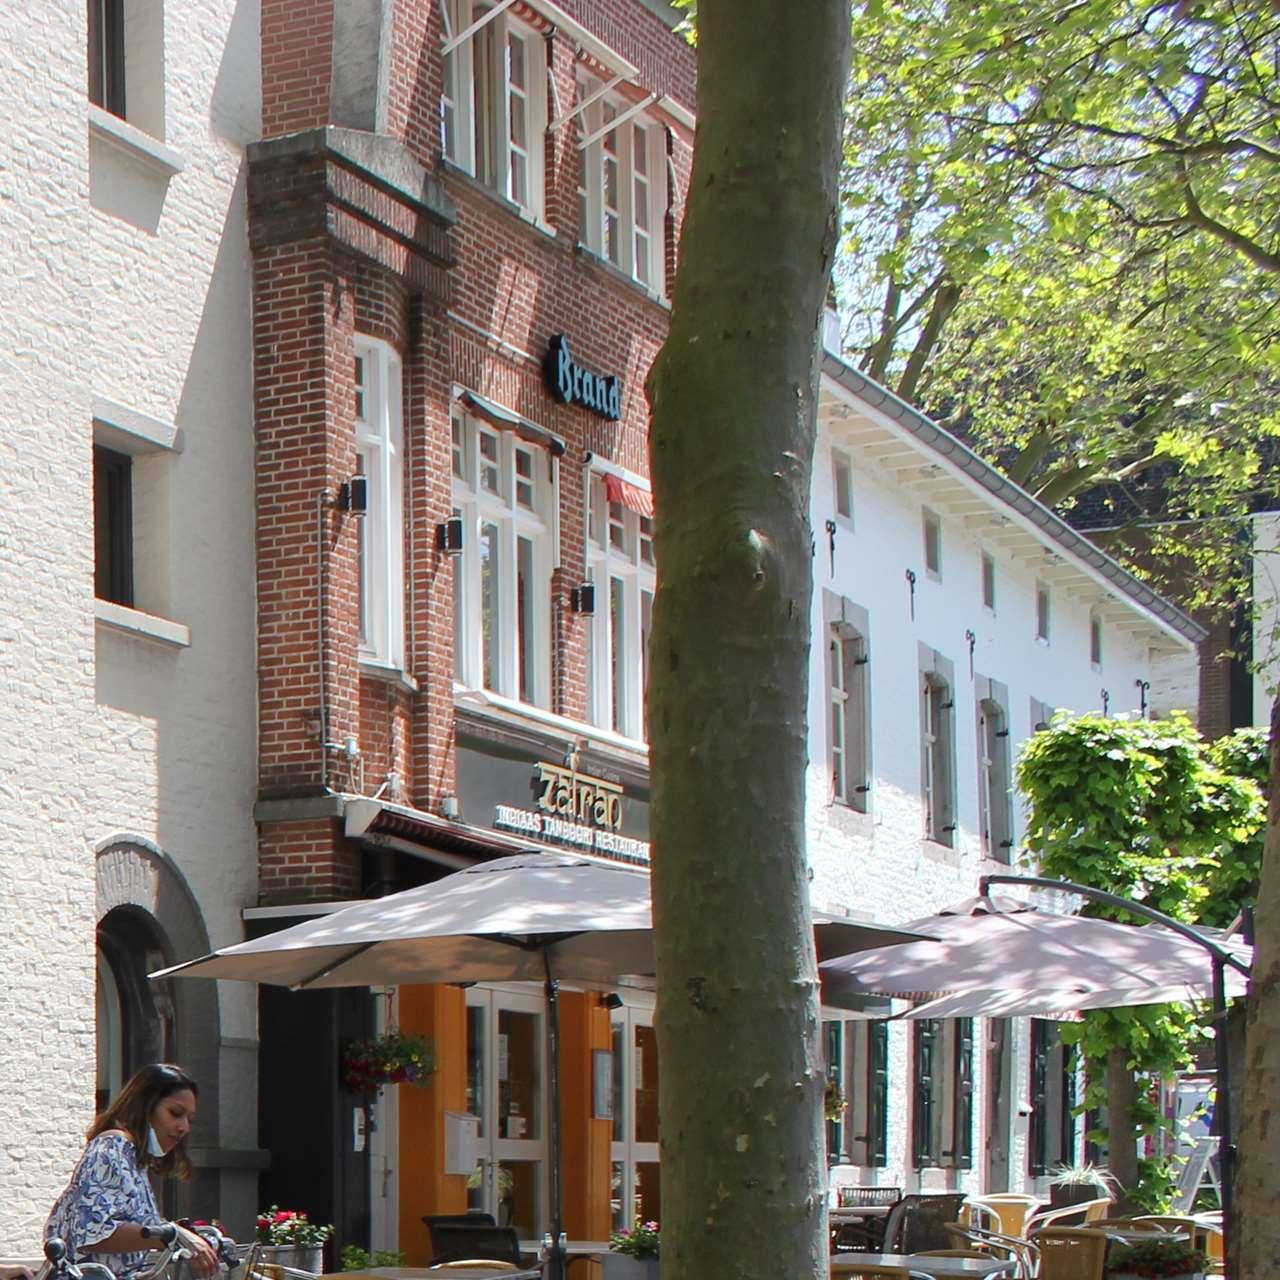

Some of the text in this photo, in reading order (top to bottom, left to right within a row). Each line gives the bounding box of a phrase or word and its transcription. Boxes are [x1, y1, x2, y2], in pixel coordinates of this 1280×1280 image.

[558, 336, 620, 420] Brand
[543, 816, 594, 846] TANDOORI
[595, 829, 651, 861] RESTAURAN
